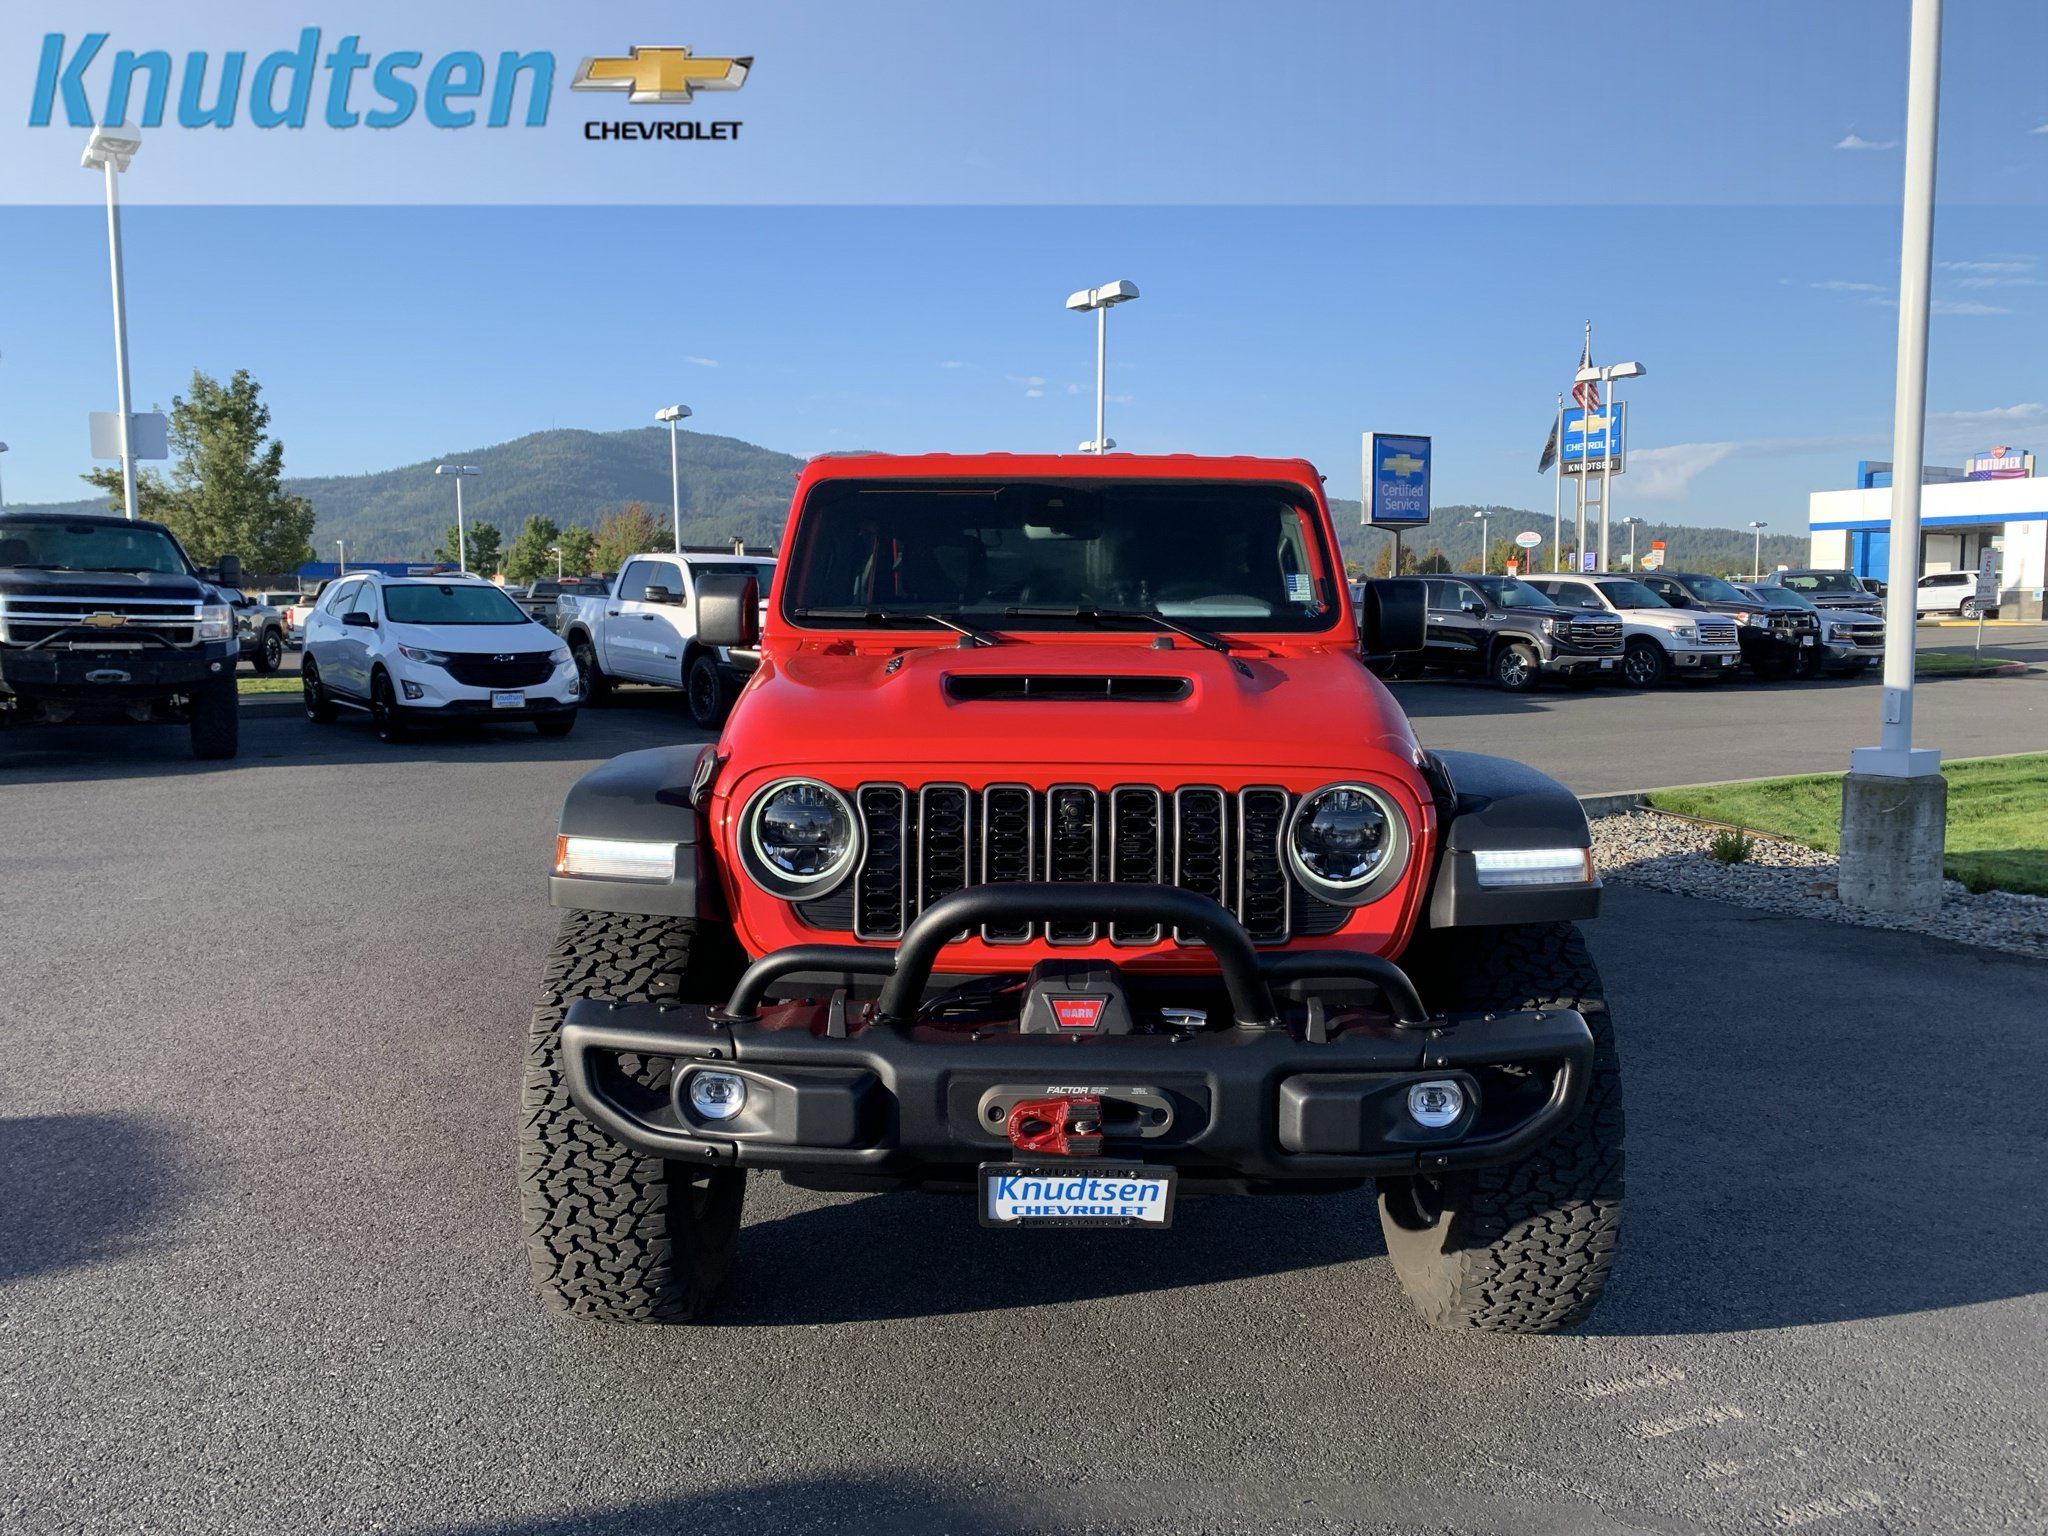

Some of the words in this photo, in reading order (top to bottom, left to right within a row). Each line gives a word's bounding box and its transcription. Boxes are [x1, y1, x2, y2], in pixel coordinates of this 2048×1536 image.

[1565, 439, 1617, 452] CHEROLT
[1976, 457, 2021, 471] AUTOPLEX
[1382, 484, 1424, 497] Certified
[1385, 498, 1420, 511] Service
[1985, 560, 1992, 572] 5
[1061, 1008, 1094, 1018] WARN
[1046, 1086, 1088, 1094] FACTOR
[998, 1176, 1160, 1202] Knudtsen
[1011, 1205, 1148, 1216] CHEVROLET
